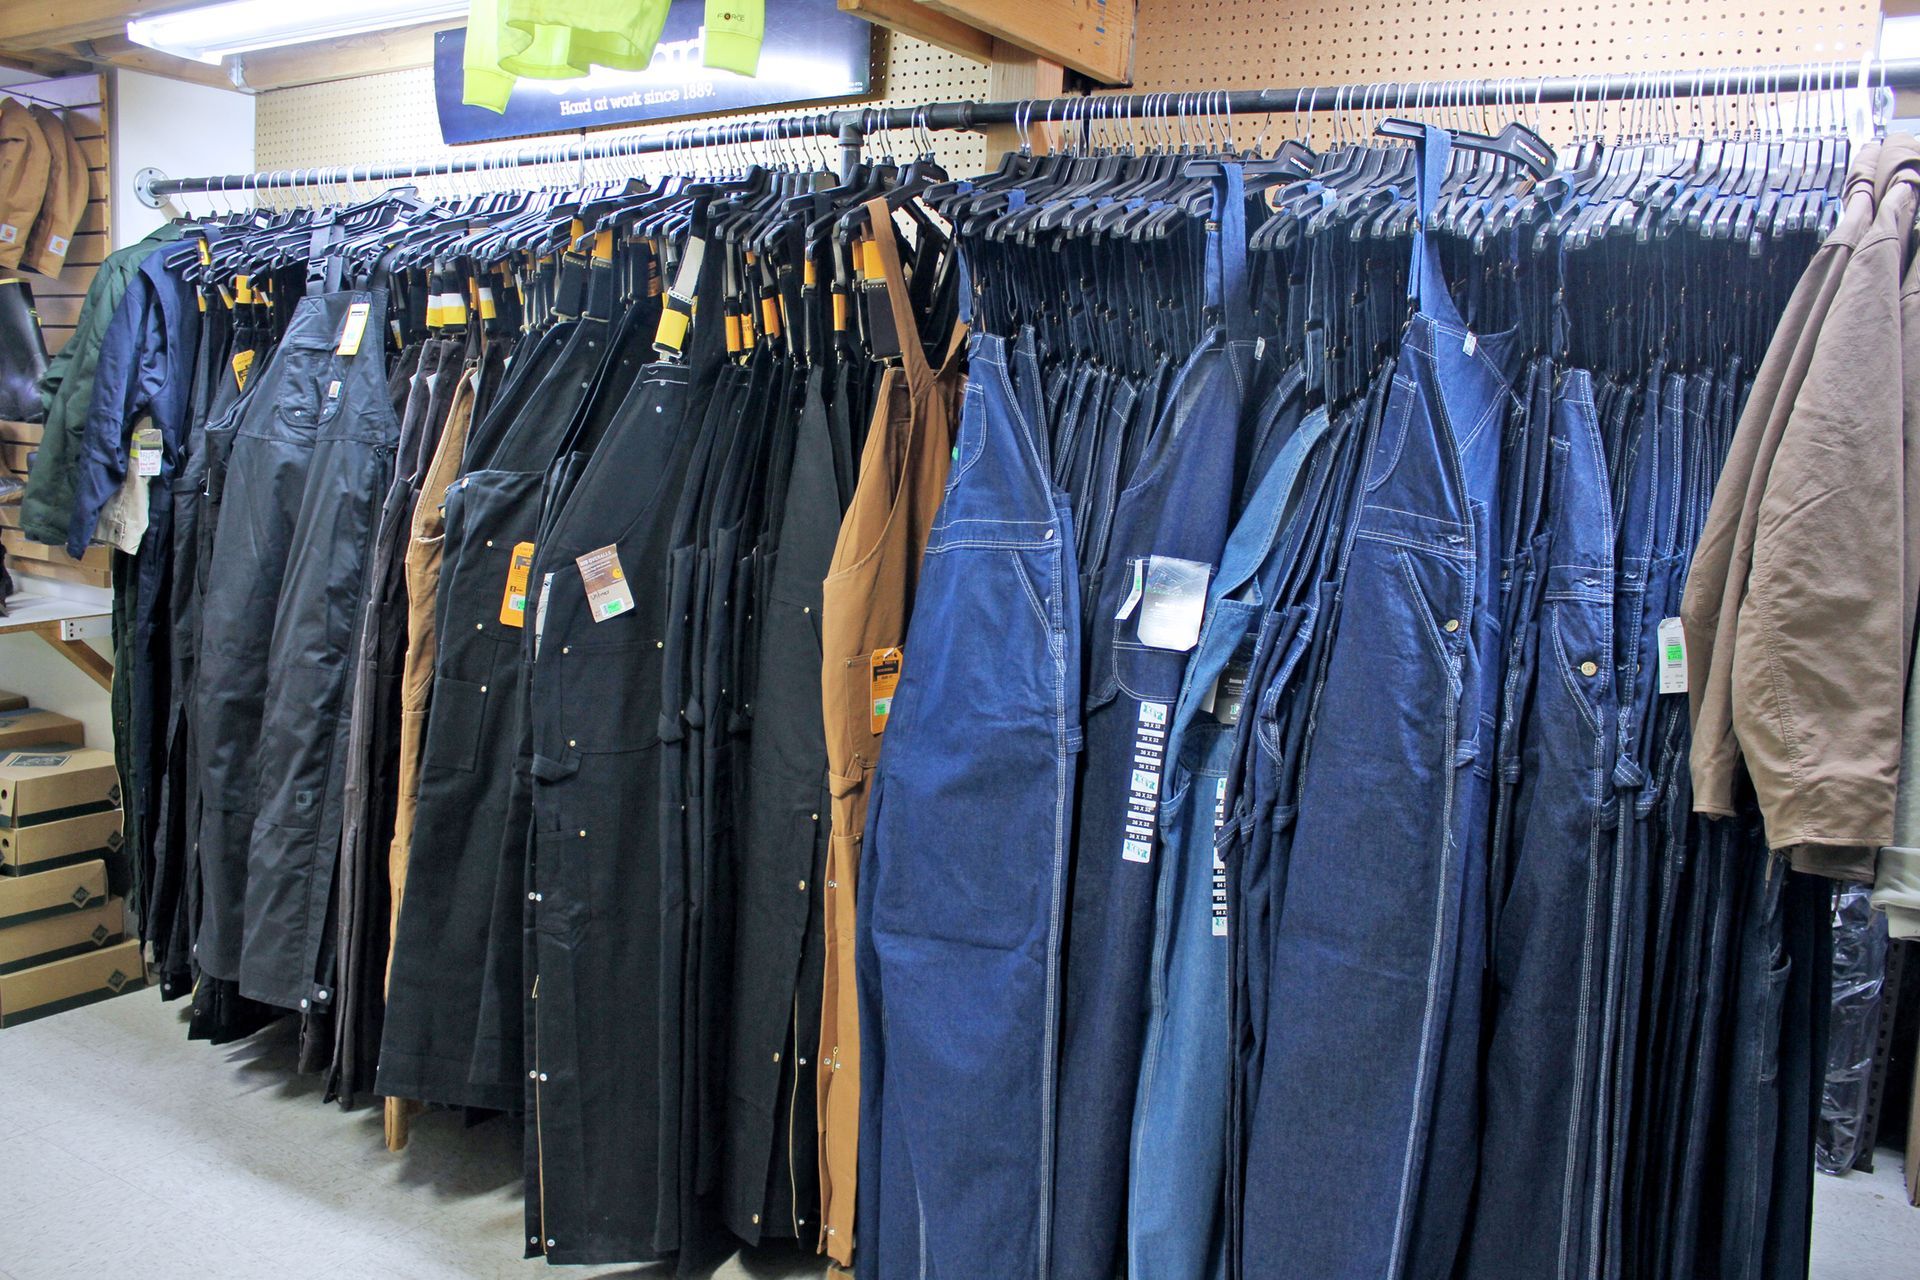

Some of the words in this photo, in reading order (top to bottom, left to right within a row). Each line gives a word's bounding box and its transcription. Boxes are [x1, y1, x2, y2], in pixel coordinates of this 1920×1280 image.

[560, 98, 592, 116] Hard
[594, 95, 608, 111] at
[609, 92, 643, 109] work
[644, 87, 679, 105] since
[683, 82, 716, 100] 1889.
